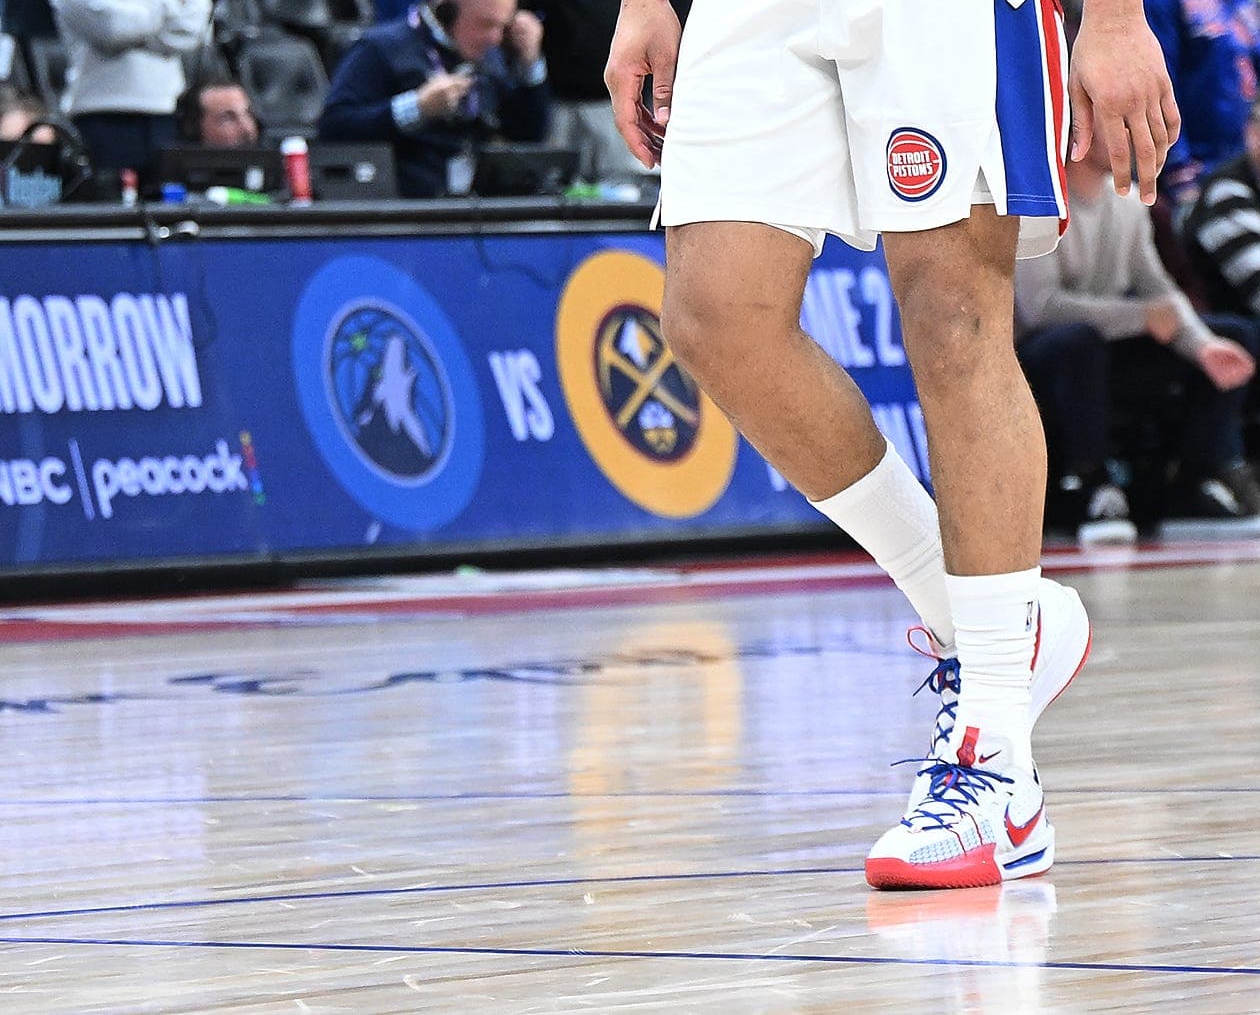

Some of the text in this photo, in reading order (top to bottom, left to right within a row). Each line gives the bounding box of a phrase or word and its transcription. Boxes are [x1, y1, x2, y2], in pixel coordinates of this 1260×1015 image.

[891, 151, 931, 165] DETROIT
[892, 163, 934, 178] PISTONS
[487, 348, 555, 442] VS
[92, 438, 249, 519] peacock
